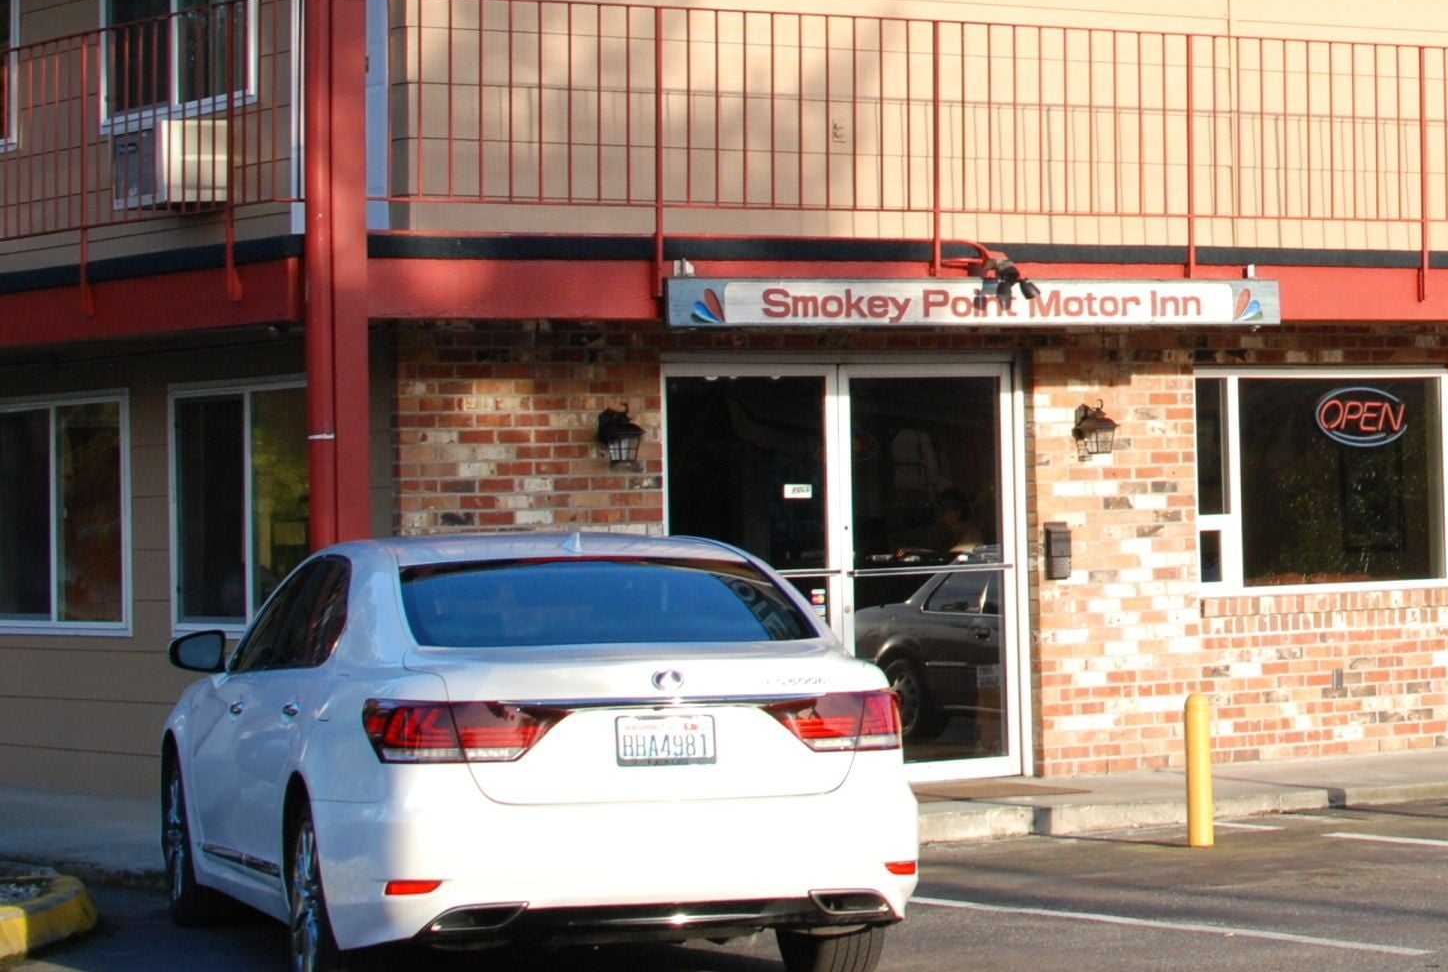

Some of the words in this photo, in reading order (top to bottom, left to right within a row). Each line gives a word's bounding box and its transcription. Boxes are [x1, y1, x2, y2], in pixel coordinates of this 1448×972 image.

[761, 288, 912, 323] Smokey
[923, 288, 1018, 318] Point
[1029, 290, 1140, 318] Motor
[1150, 290, 1202, 317] Inn
[1320, 399, 1405, 431] OPEN
[622, 733, 708, 757] BBA4981
